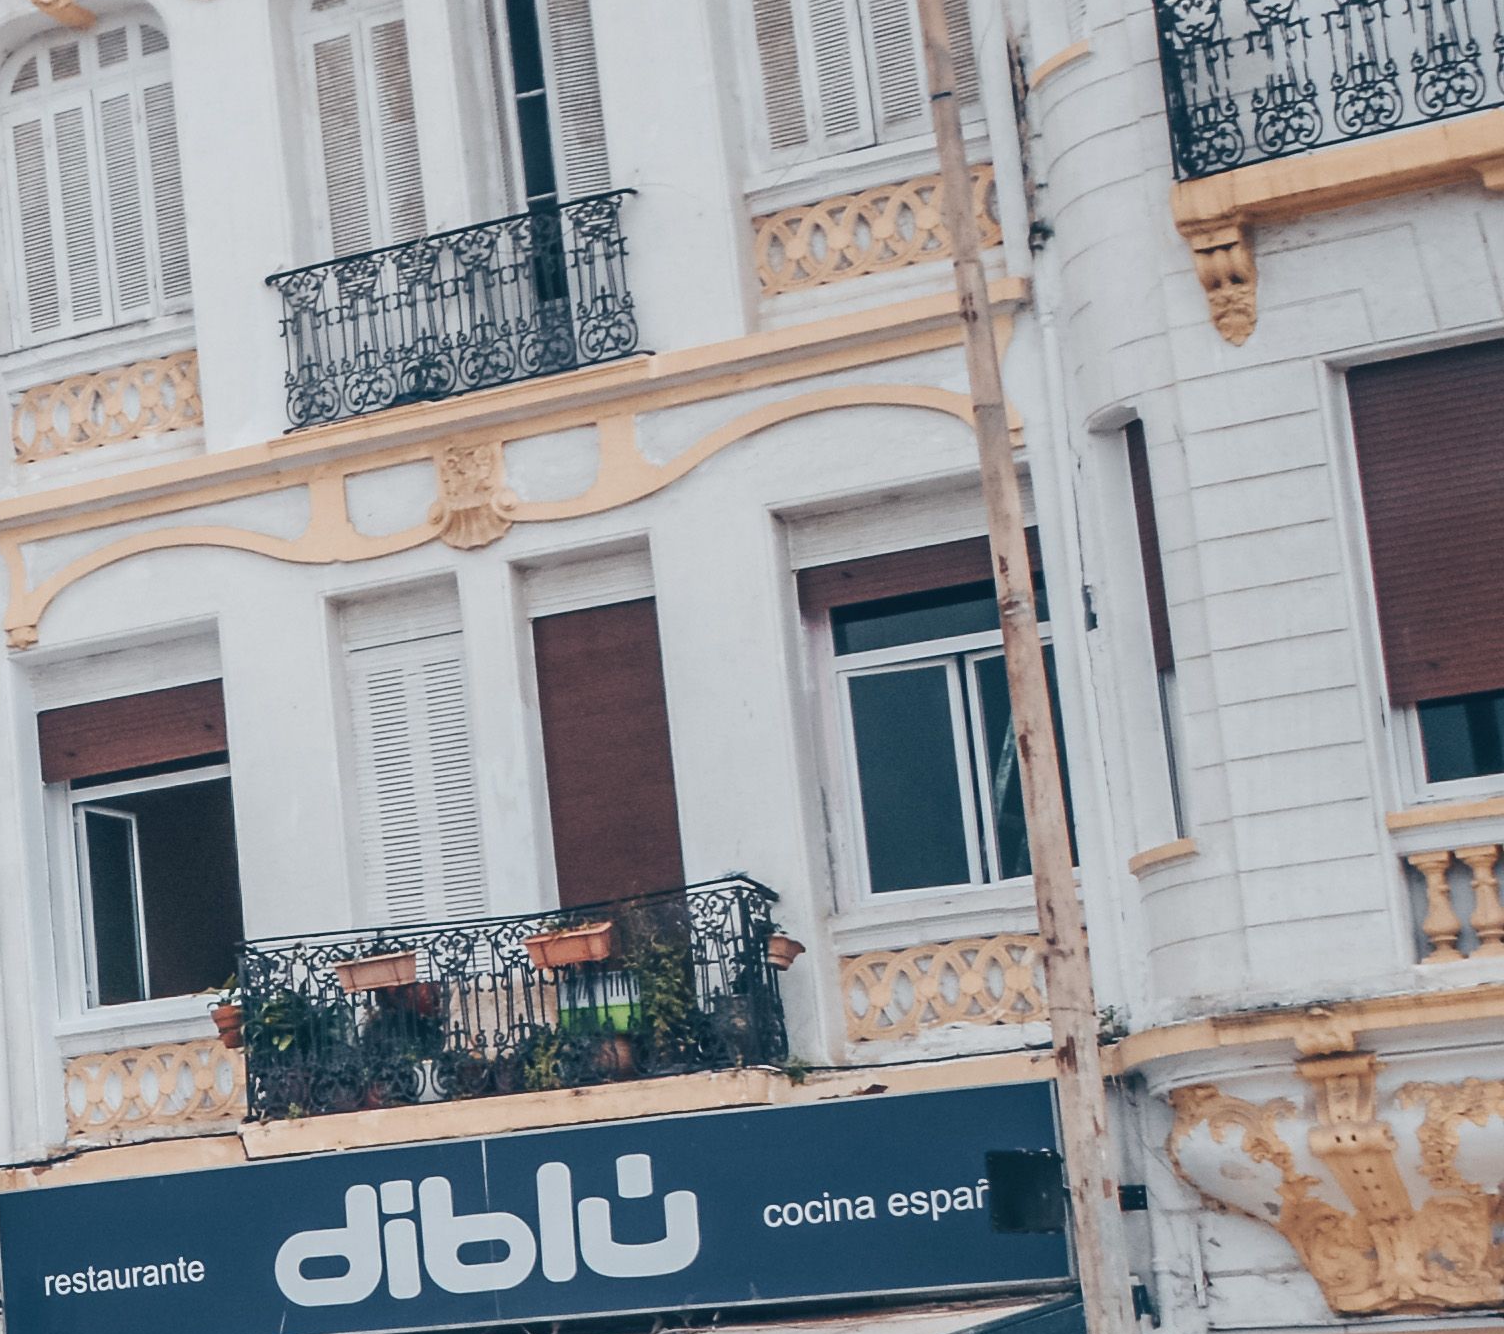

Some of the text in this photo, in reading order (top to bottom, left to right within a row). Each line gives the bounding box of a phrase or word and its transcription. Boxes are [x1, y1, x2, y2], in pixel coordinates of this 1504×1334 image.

[763, 1178, 990, 1228] cocina españ
[44, 1256, 205, 1296] restaurante
